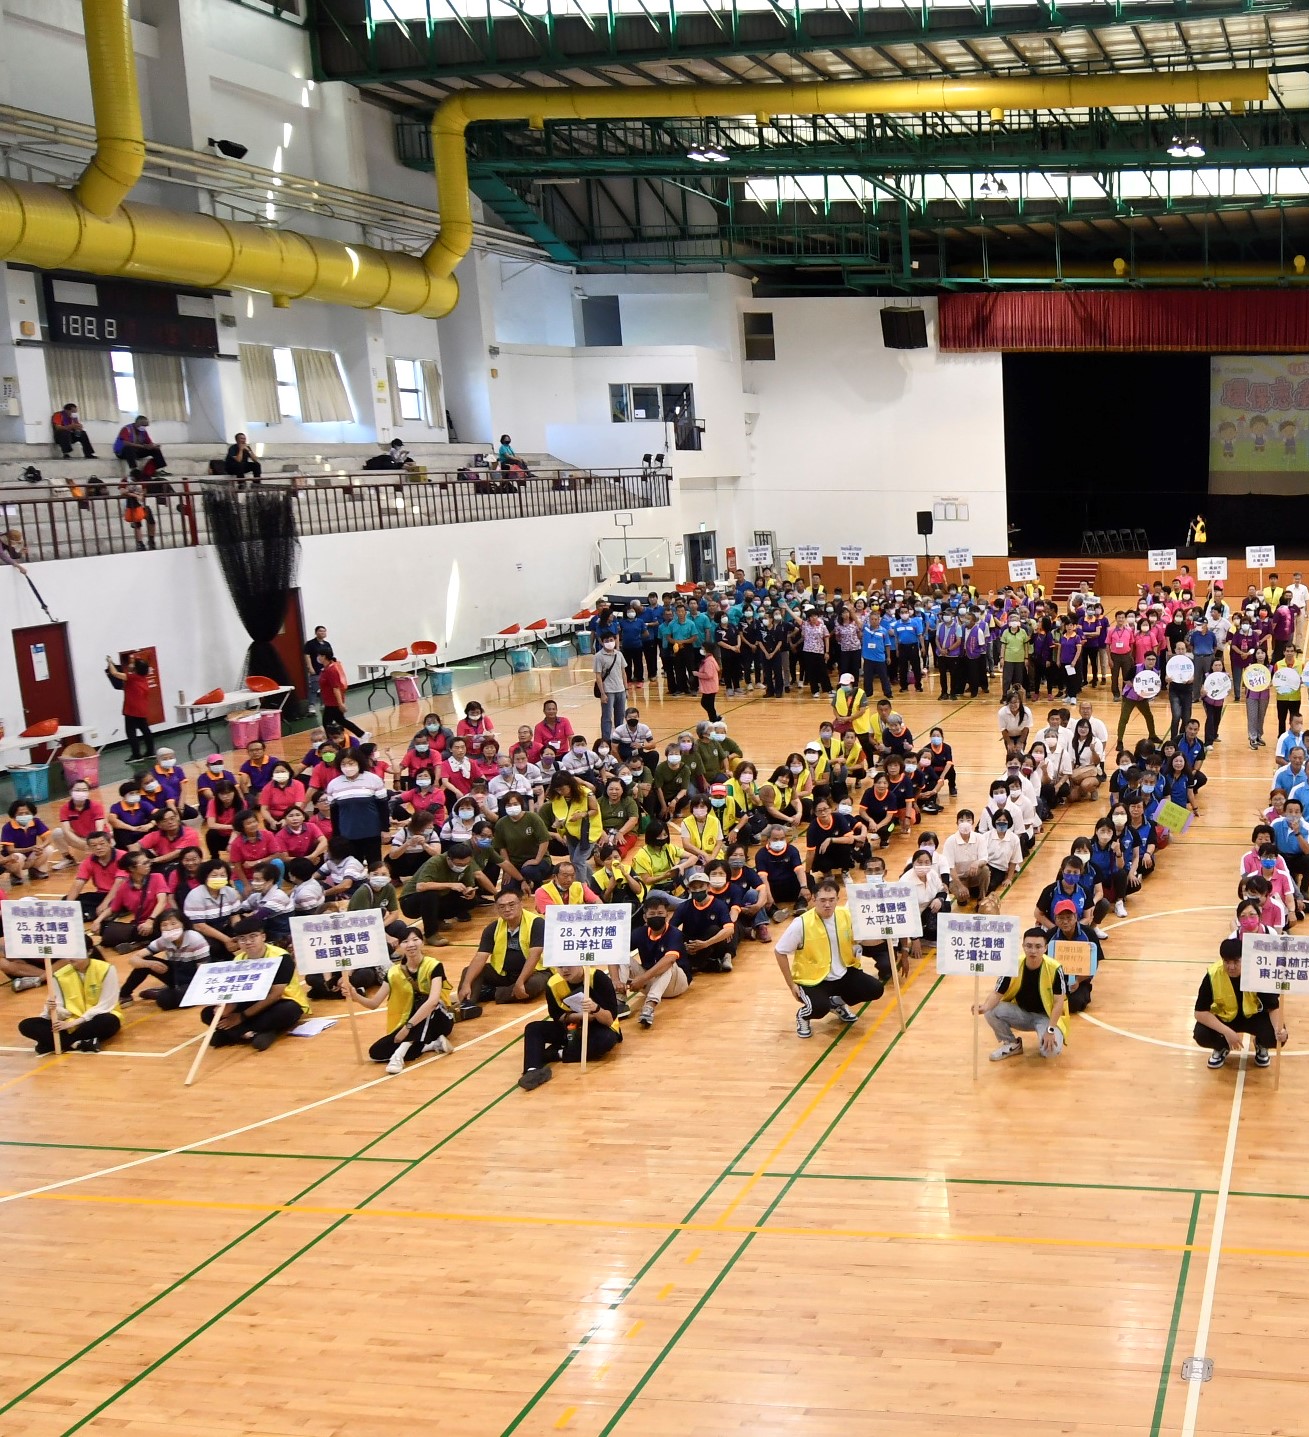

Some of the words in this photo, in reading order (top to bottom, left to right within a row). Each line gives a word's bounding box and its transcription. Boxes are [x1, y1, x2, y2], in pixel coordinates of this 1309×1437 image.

[861, 905, 874, 913] 29.
[866, 914, 907, 925] 太平社區
[18, 922, 32, 931] 25.
[560, 928, 575, 937] 28.
[580, 926, 616, 937] 大村鄉
[310, 937, 326, 946] 27.
[563, 938, 613, 951] 田洋社區
[951, 937, 965, 946] 30.
[970, 936, 1005, 948] 花壇鄉
[954, 950, 1001, 961] 花壇社區
[1256, 957, 1271, 966] 31.
[1258, 969, 1308, 980] 東北社區
